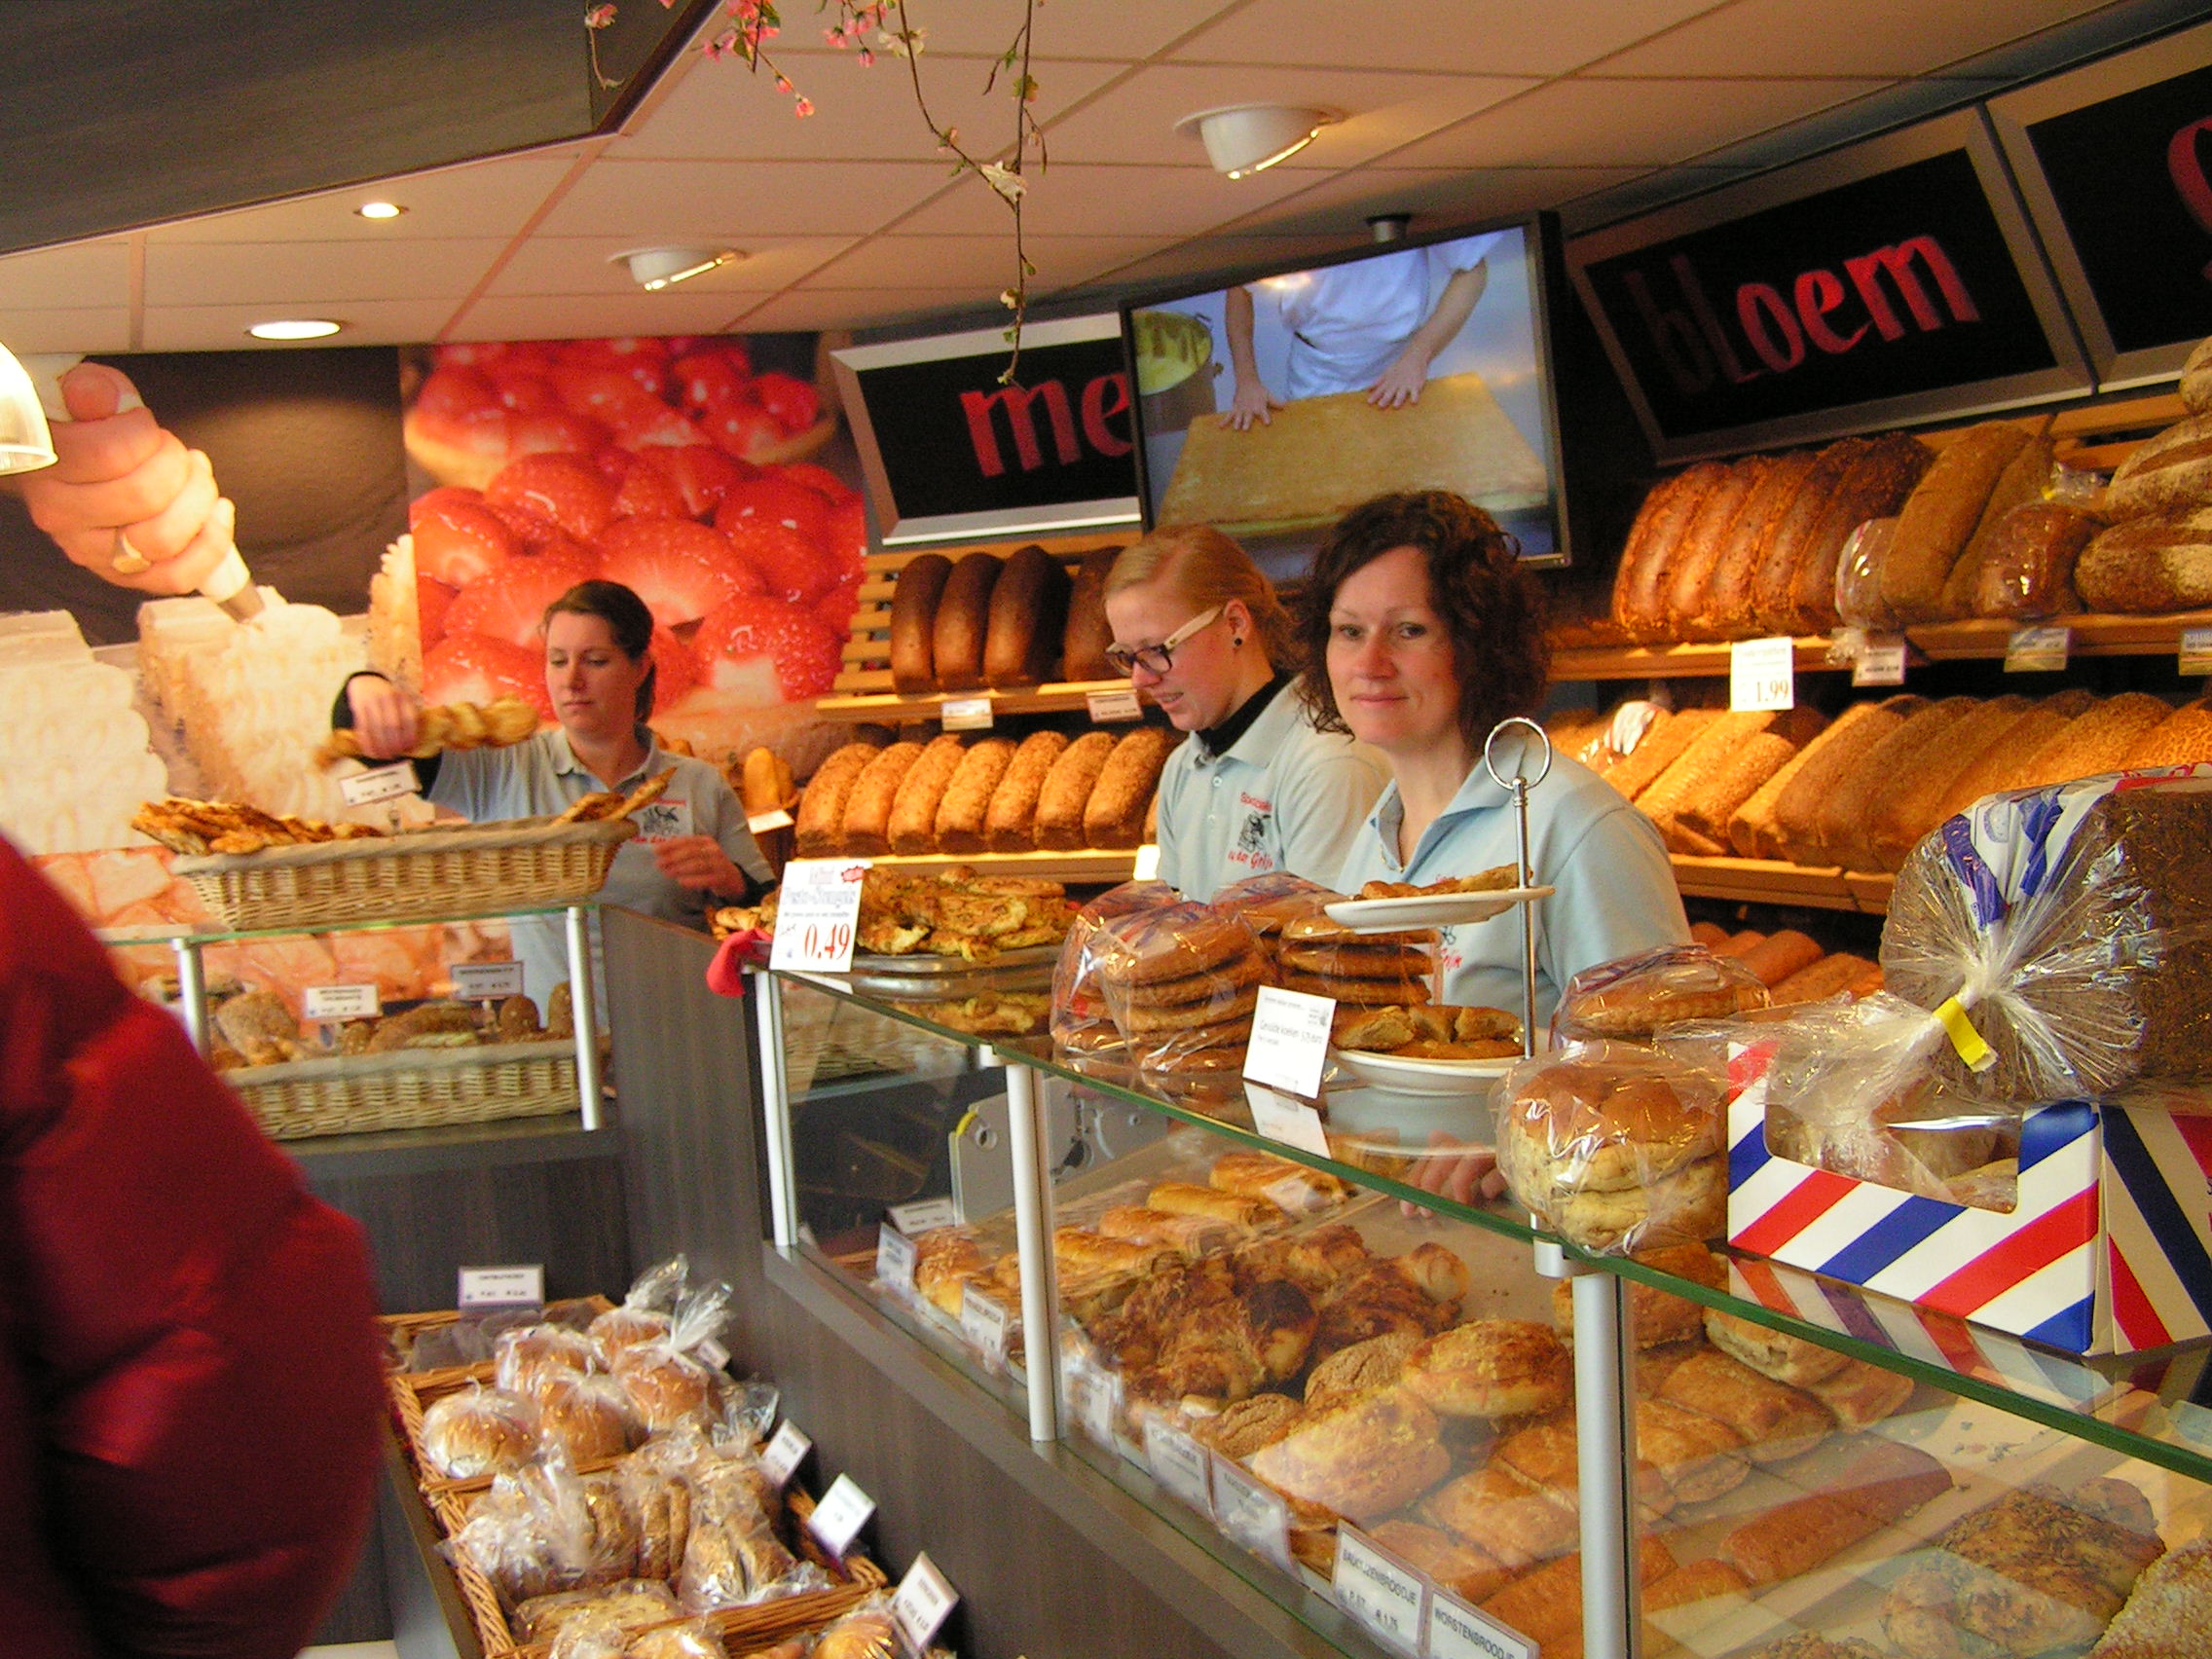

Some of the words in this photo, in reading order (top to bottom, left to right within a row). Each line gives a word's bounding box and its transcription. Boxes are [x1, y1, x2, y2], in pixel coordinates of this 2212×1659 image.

[1623, 236, 1980, 390] bloem
[959, 372, 1134, 477] me
[1756, 681, 1789, 703] 1.99
[804, 923, 851, 960] 0.49
